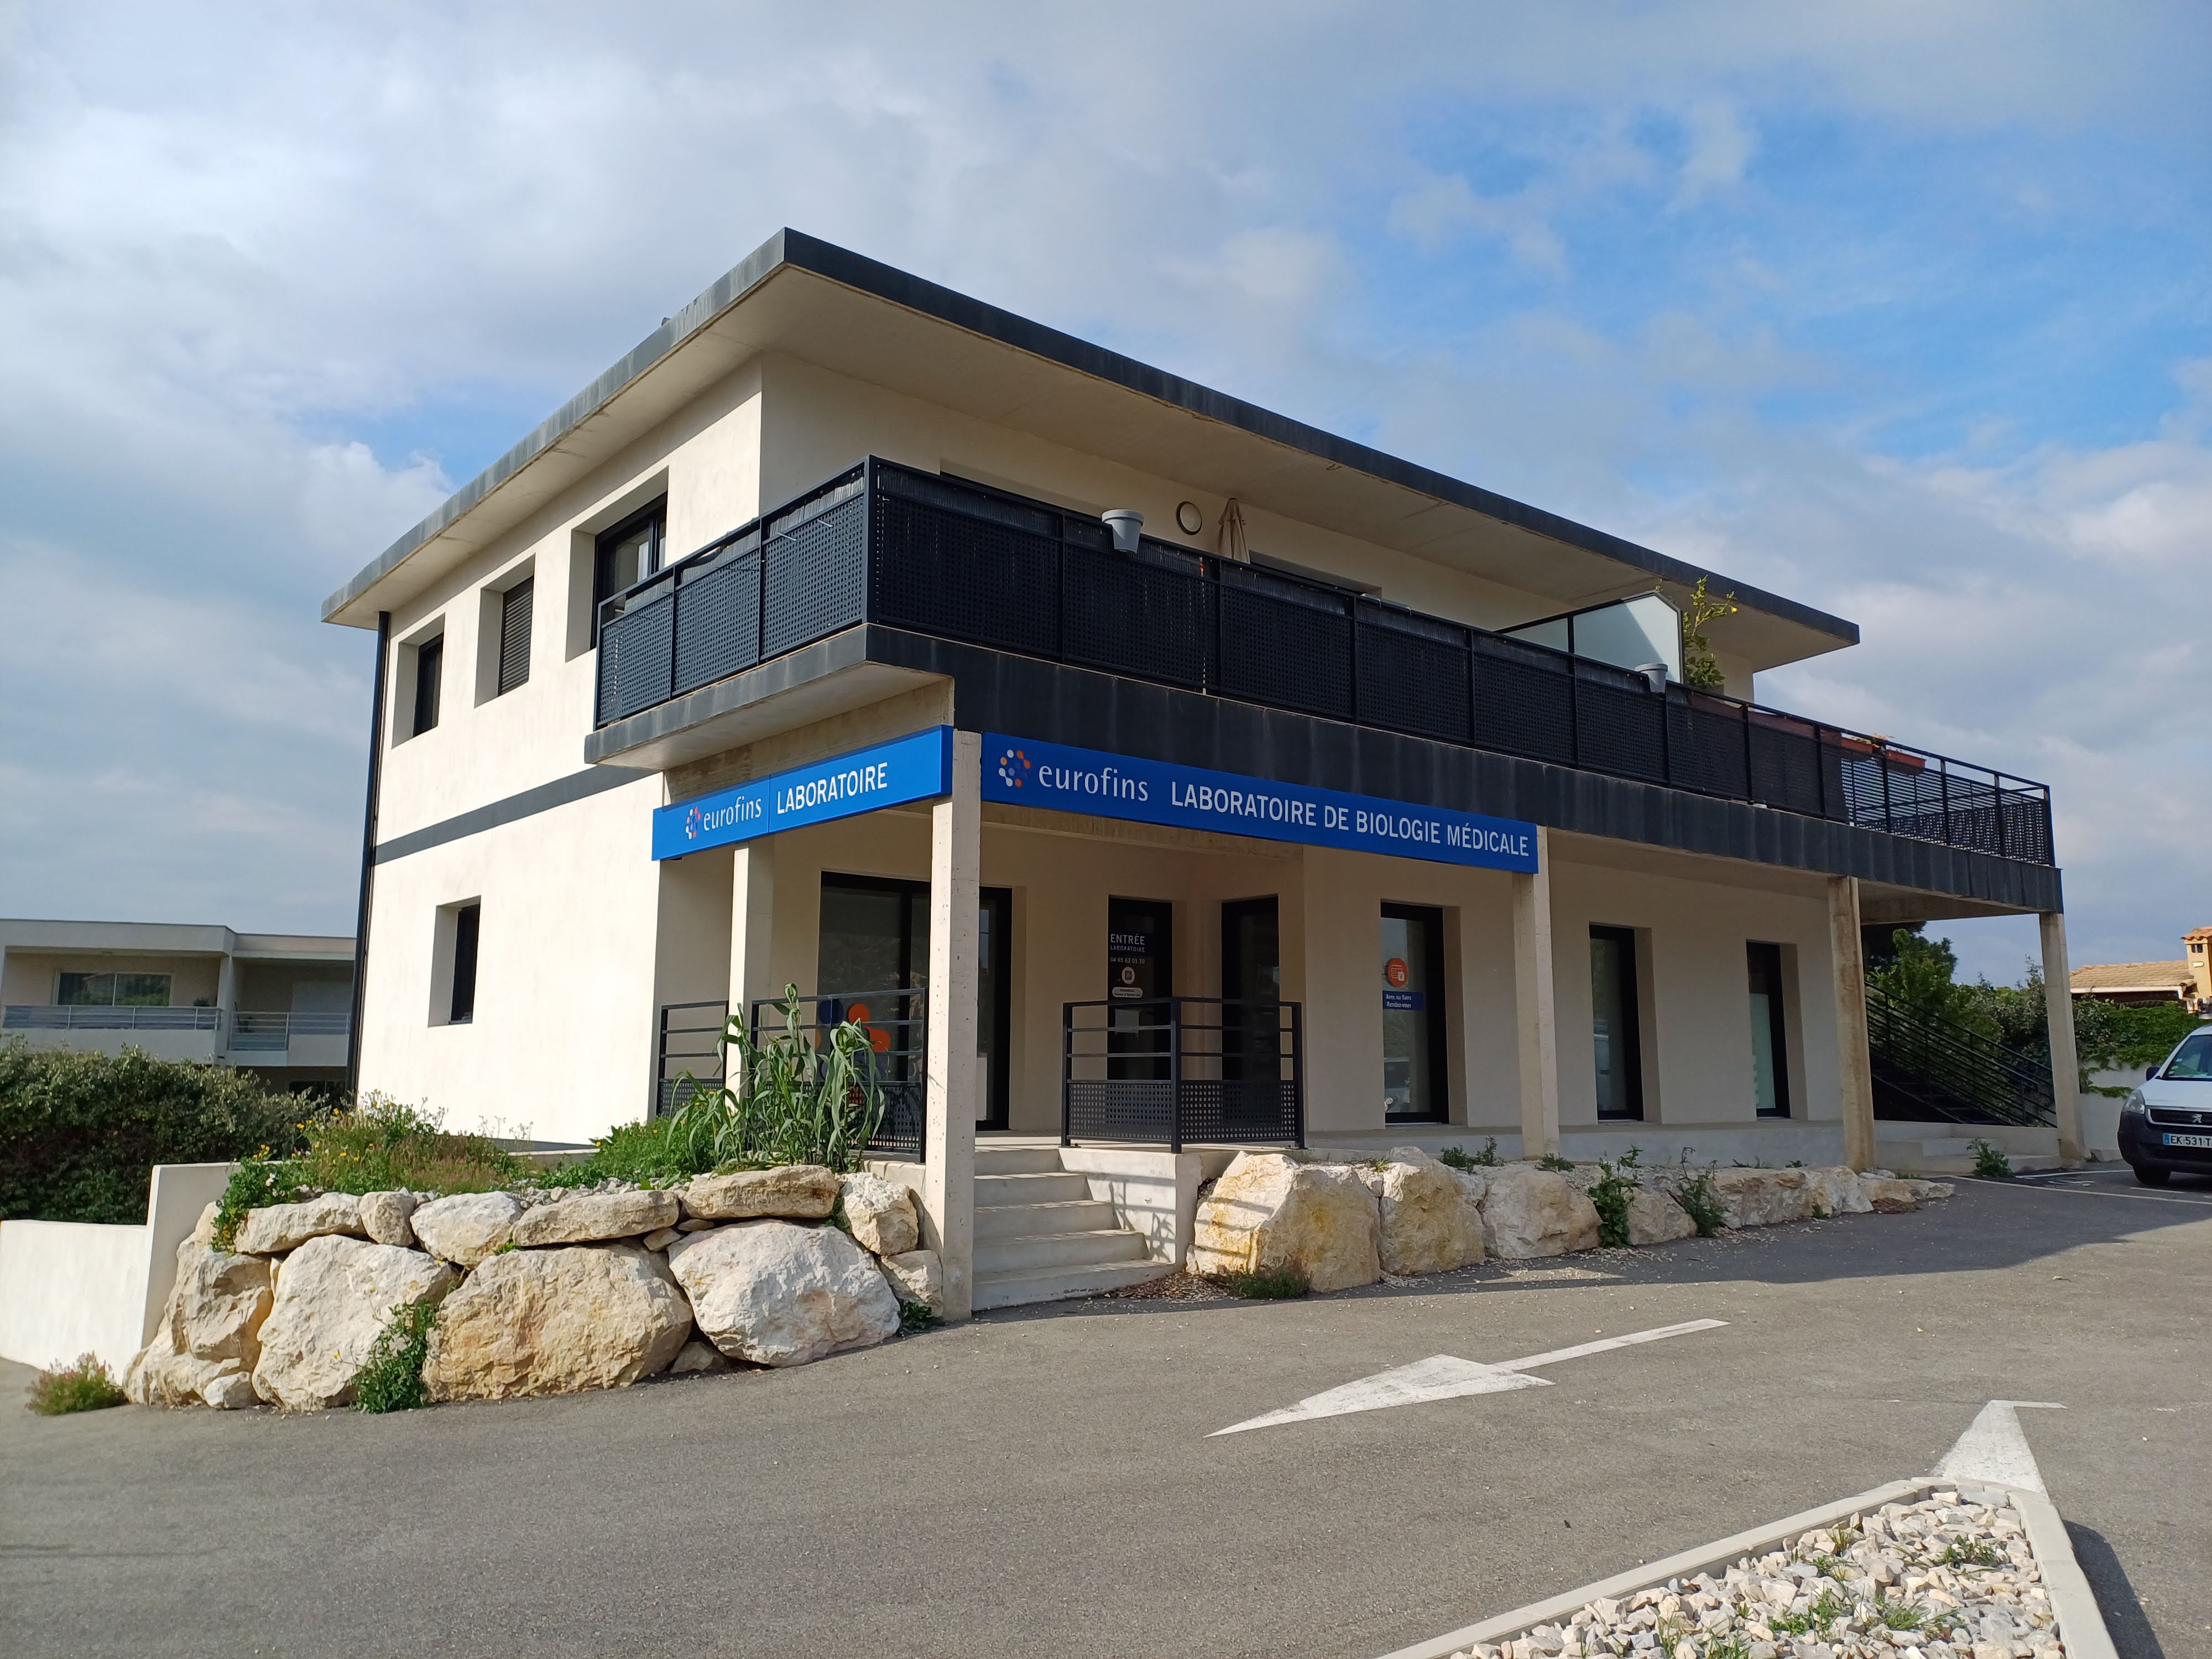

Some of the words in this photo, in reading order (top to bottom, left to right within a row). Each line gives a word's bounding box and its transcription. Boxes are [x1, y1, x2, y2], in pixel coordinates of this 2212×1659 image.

[703, 796, 761, 831] eurofins
[777, 761, 888, 815] LABORATOIRE
[1039, 765, 1149, 801] eurofins
[1171, 781, 1317, 826] LABORATOIRE
[1324, 805, 1349, 831] DE
[1356, 810, 1441, 844] BIOLOGIE
[1447, 823, 1529, 857] MÉDICALE
[1110, 934, 1145, 945] ENTRÉE
[2171, 1135, 2212, 1146] EK-531-T
